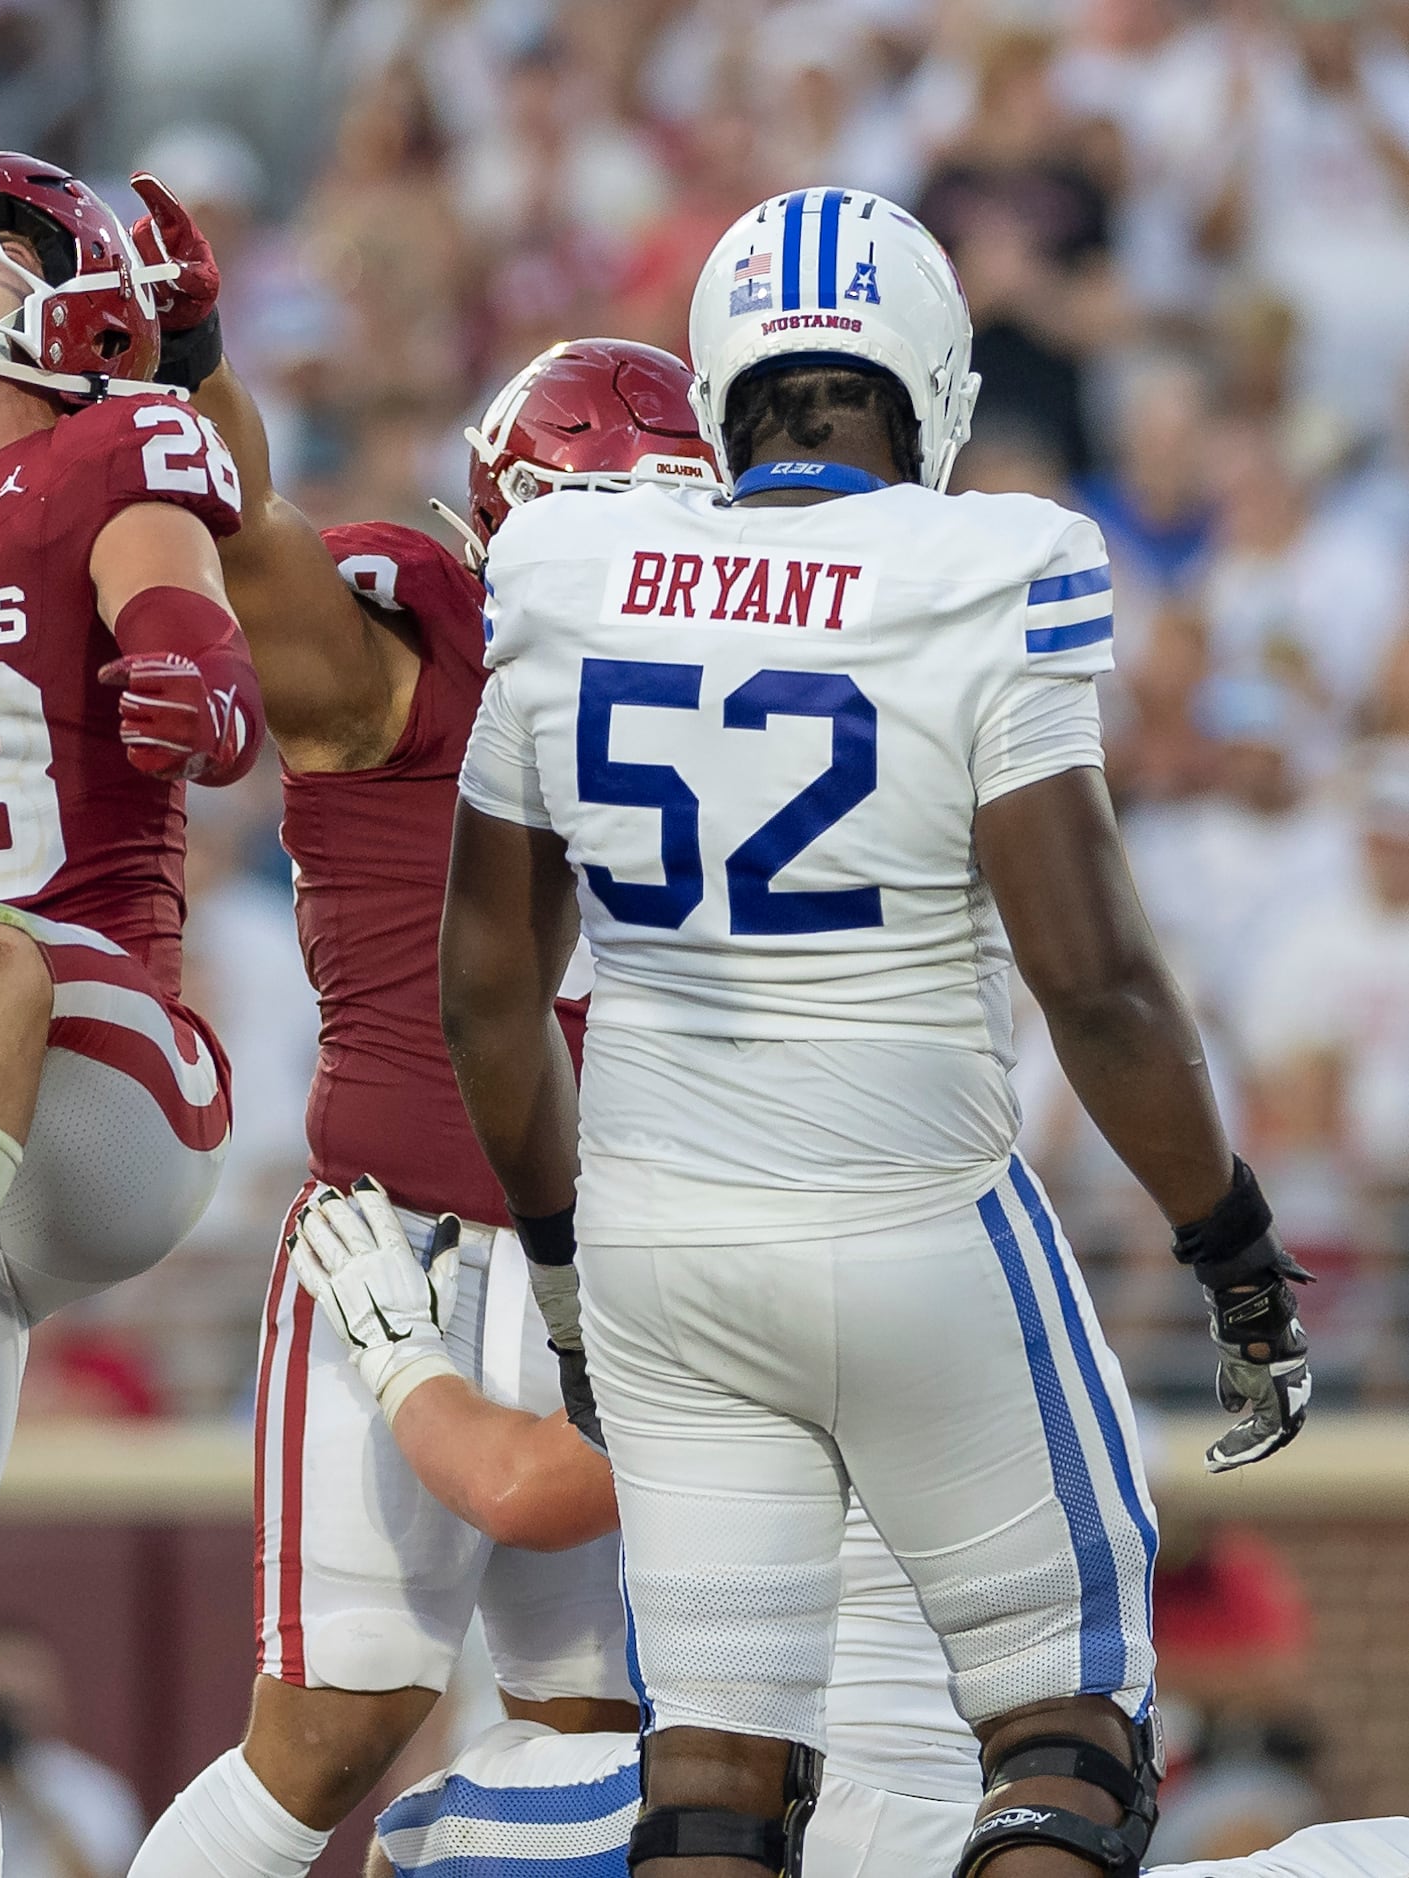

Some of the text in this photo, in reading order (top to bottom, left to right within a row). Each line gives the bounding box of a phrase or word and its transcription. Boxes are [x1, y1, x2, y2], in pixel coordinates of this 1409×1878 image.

[761, 314, 863, 336] MUSTANGS
[133, 404, 242, 513] 28
[656, 463, 704, 478] OKLAHOMA
[620, 550, 863, 631] BRYANT
[576, 657, 885, 936] 52
